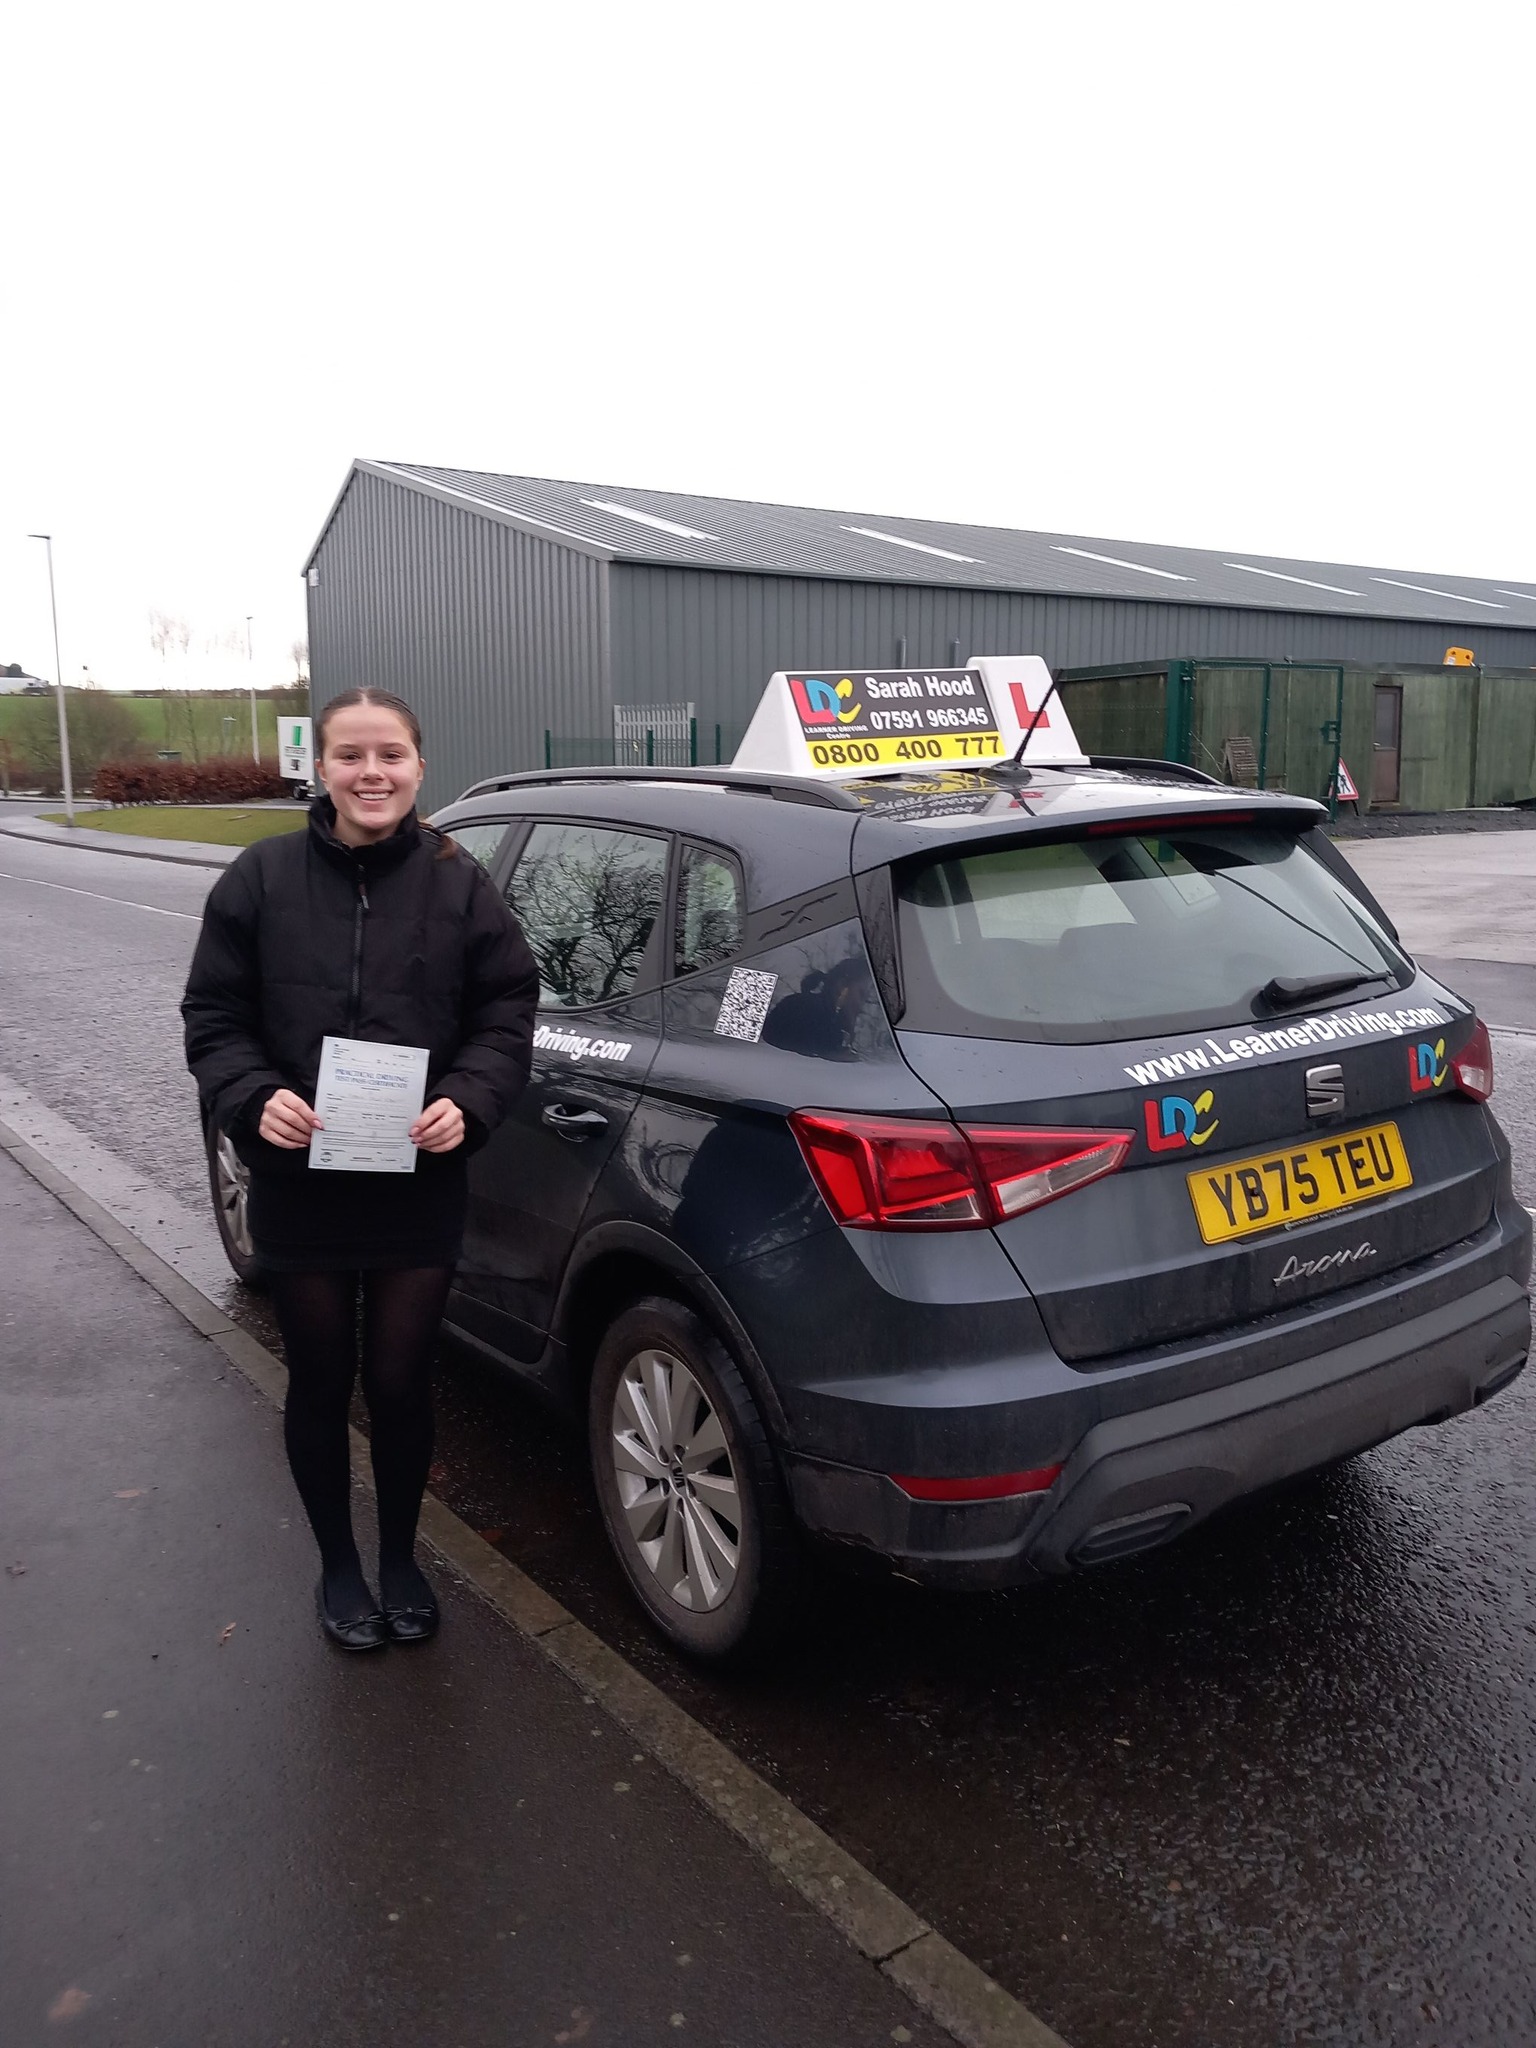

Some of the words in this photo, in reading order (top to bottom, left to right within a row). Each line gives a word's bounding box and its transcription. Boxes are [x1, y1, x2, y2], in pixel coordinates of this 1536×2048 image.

[789, 678, 862, 724] LDC
[864, 676, 924, 699] Sarah
[923, 674, 976, 697] Hood
[1008, 682, 1051, 729] L
[804, 726, 838, 734] LEARNER
[838, 724, 869, 733] DRIVING
[869, 709, 925, 730] 07591
[925, 706, 989, 728] 966345
[813, 743, 880, 765] 0800
[896, 739, 942, 760] 400
[955, 735, 999, 756] 777
[1123, 1004, 1446, 1087] www.LearnerDriving.com
[1408, 1038, 1449, 1093] LDC
[1144, 1089, 1220, 1152] LDC
[1208, 1153, 1320, 1227] YB75
[1321, 1133, 1396, 1195] TEU
[1273, 1241, 1378, 1287] Arona
